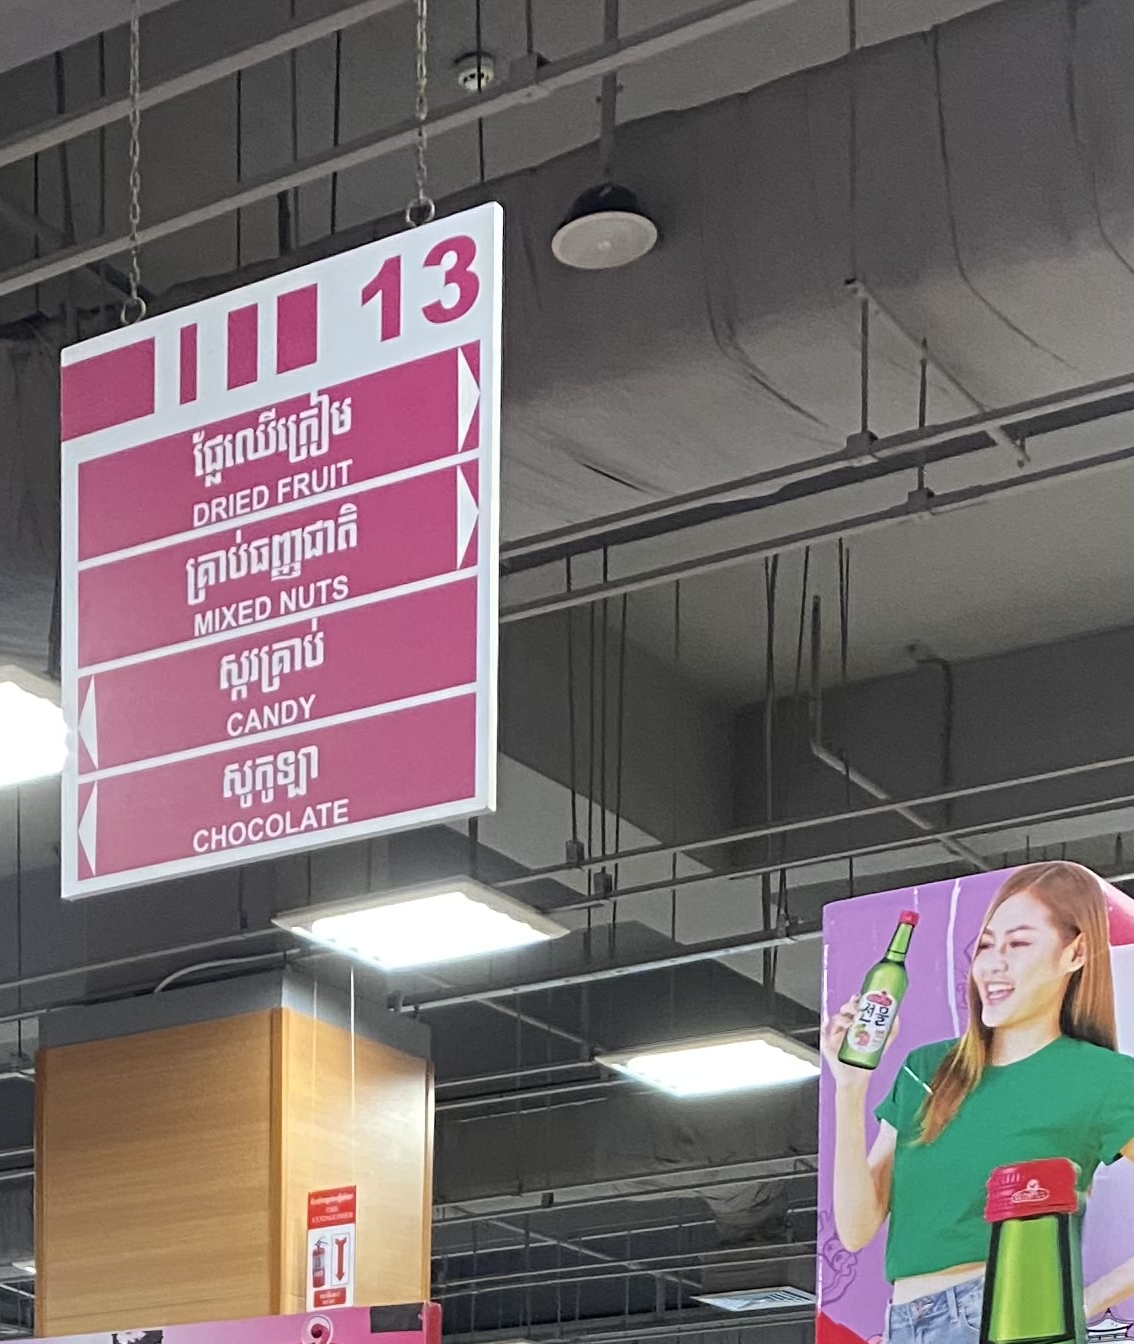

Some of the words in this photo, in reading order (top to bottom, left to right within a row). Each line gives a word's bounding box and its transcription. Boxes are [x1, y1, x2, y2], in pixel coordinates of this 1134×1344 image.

[360, 235, 482, 343] 13
[193, 484, 270, 528] DRIED
[277, 458, 354, 504] FRUIT
[194, 595, 272, 637] MIXED
[279, 574, 350, 615] NUTS
[227, 694, 316, 737] CANDY
[192, 799, 350, 853] CHOCOLATE
[859, 1002, 890, 1026] 선물
